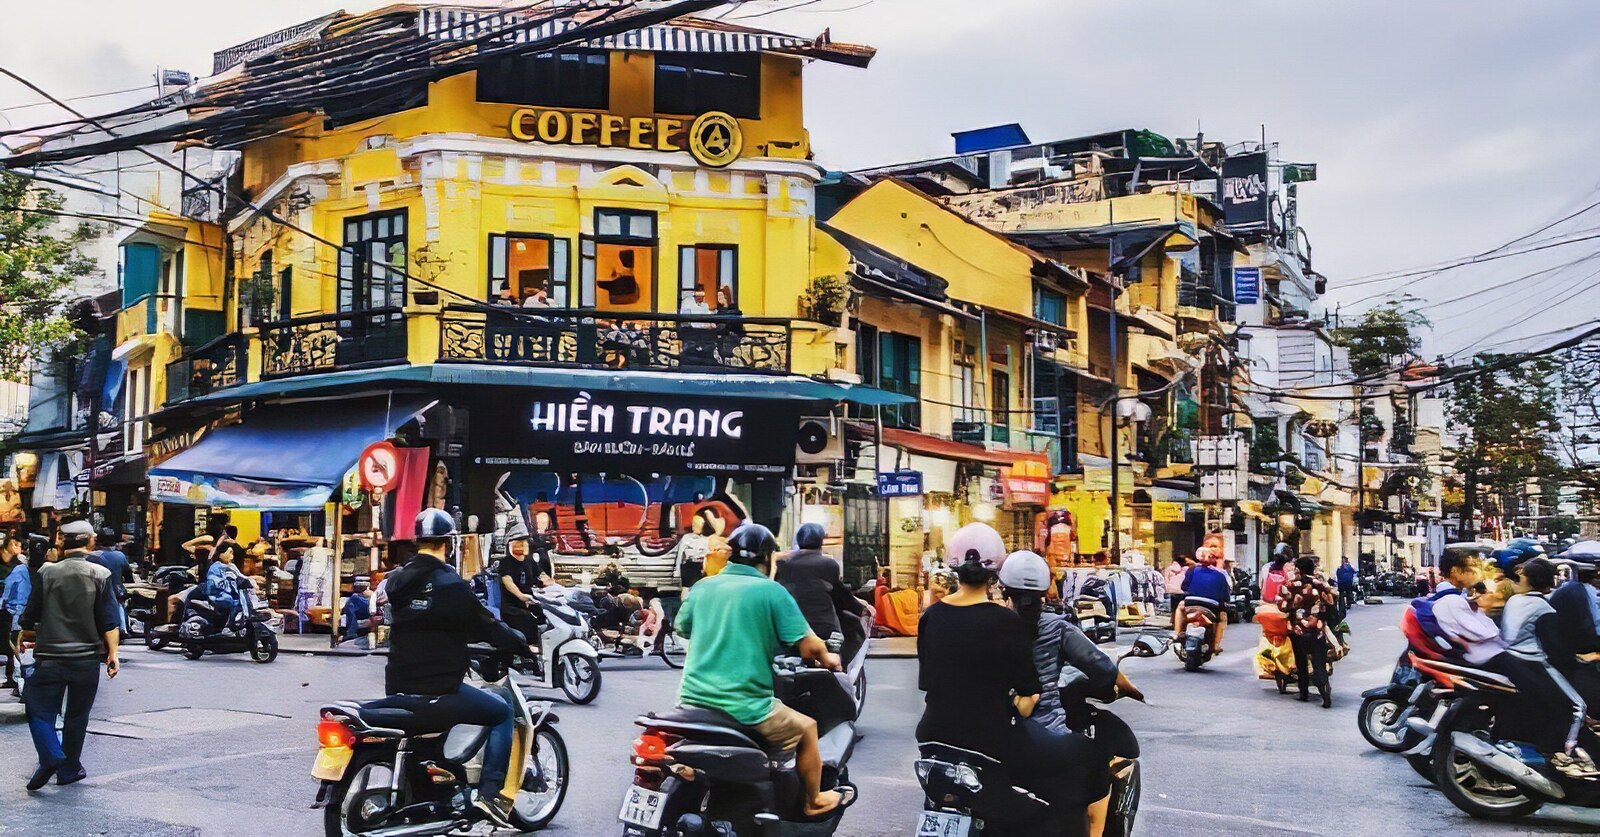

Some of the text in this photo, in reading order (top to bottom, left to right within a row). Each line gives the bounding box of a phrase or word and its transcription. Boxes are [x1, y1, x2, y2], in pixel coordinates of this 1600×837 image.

[511, 109, 681, 151] COFFEE
[532, 391, 743, 439] HIỀN TRANG
